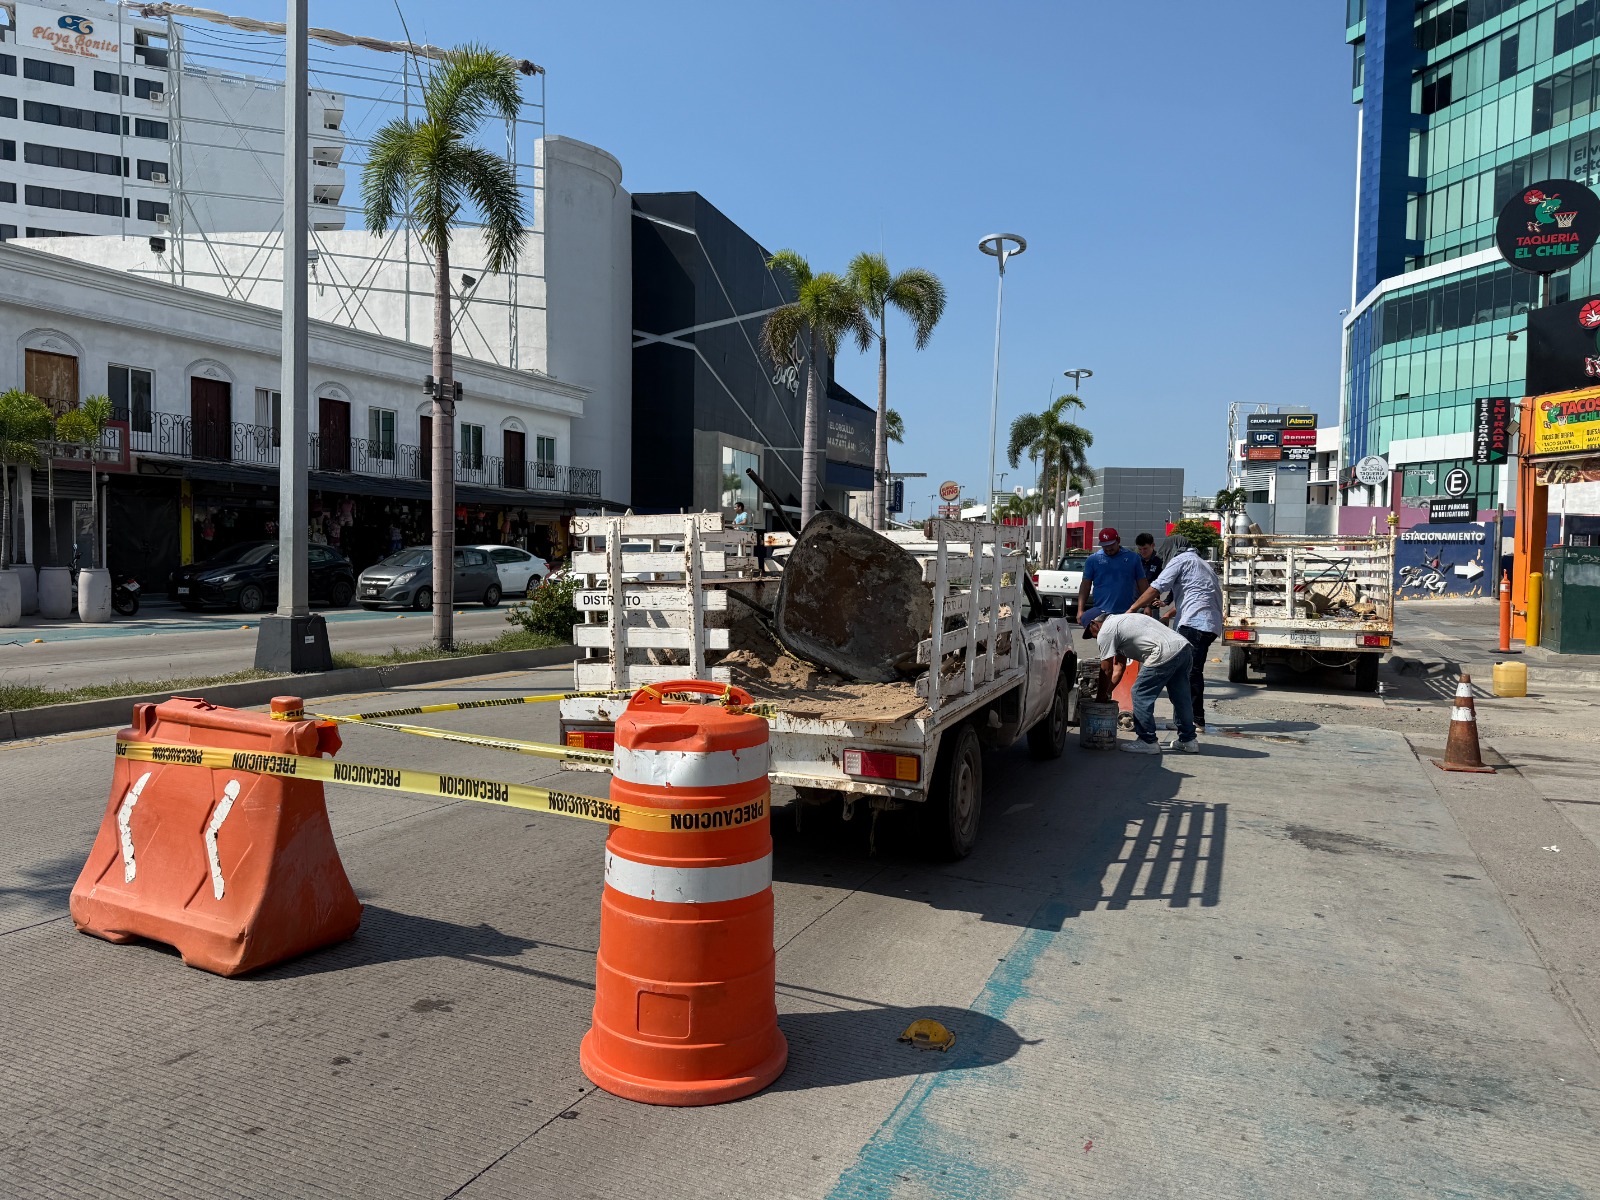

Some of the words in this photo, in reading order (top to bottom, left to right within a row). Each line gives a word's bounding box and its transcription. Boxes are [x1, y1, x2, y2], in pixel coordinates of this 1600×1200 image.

[32, 26, 69, 46] Playa
[75, 34, 118, 53] Bonita
[1516, 232, 1579, 246] TAQUERIA
[1515, 247, 1532, 259] EL
[1493, 399, 1506, 448] ENTRADA
[1567, 414, 1578, 424] EL
[1477, 398, 1489, 463] ESTACIONAMIENTO
[1450, 473, 1463, 491] E
[942, 488, 959, 497] KING
[1438, 510, 1470, 518] OBLIGATORIO
[1447, 503, 1469, 511] PARKING
[1401, 531, 1485, 541] ESTACIONAMIENTO
[232, 752, 297, 775] PRECAUCION
[334, 763, 401, 787] PRECAUCION
[439, 775, 509, 802] PRECAUCION
[548, 791, 621, 823] PRECAUCION
[670, 799, 765, 830] PRECAUCION
